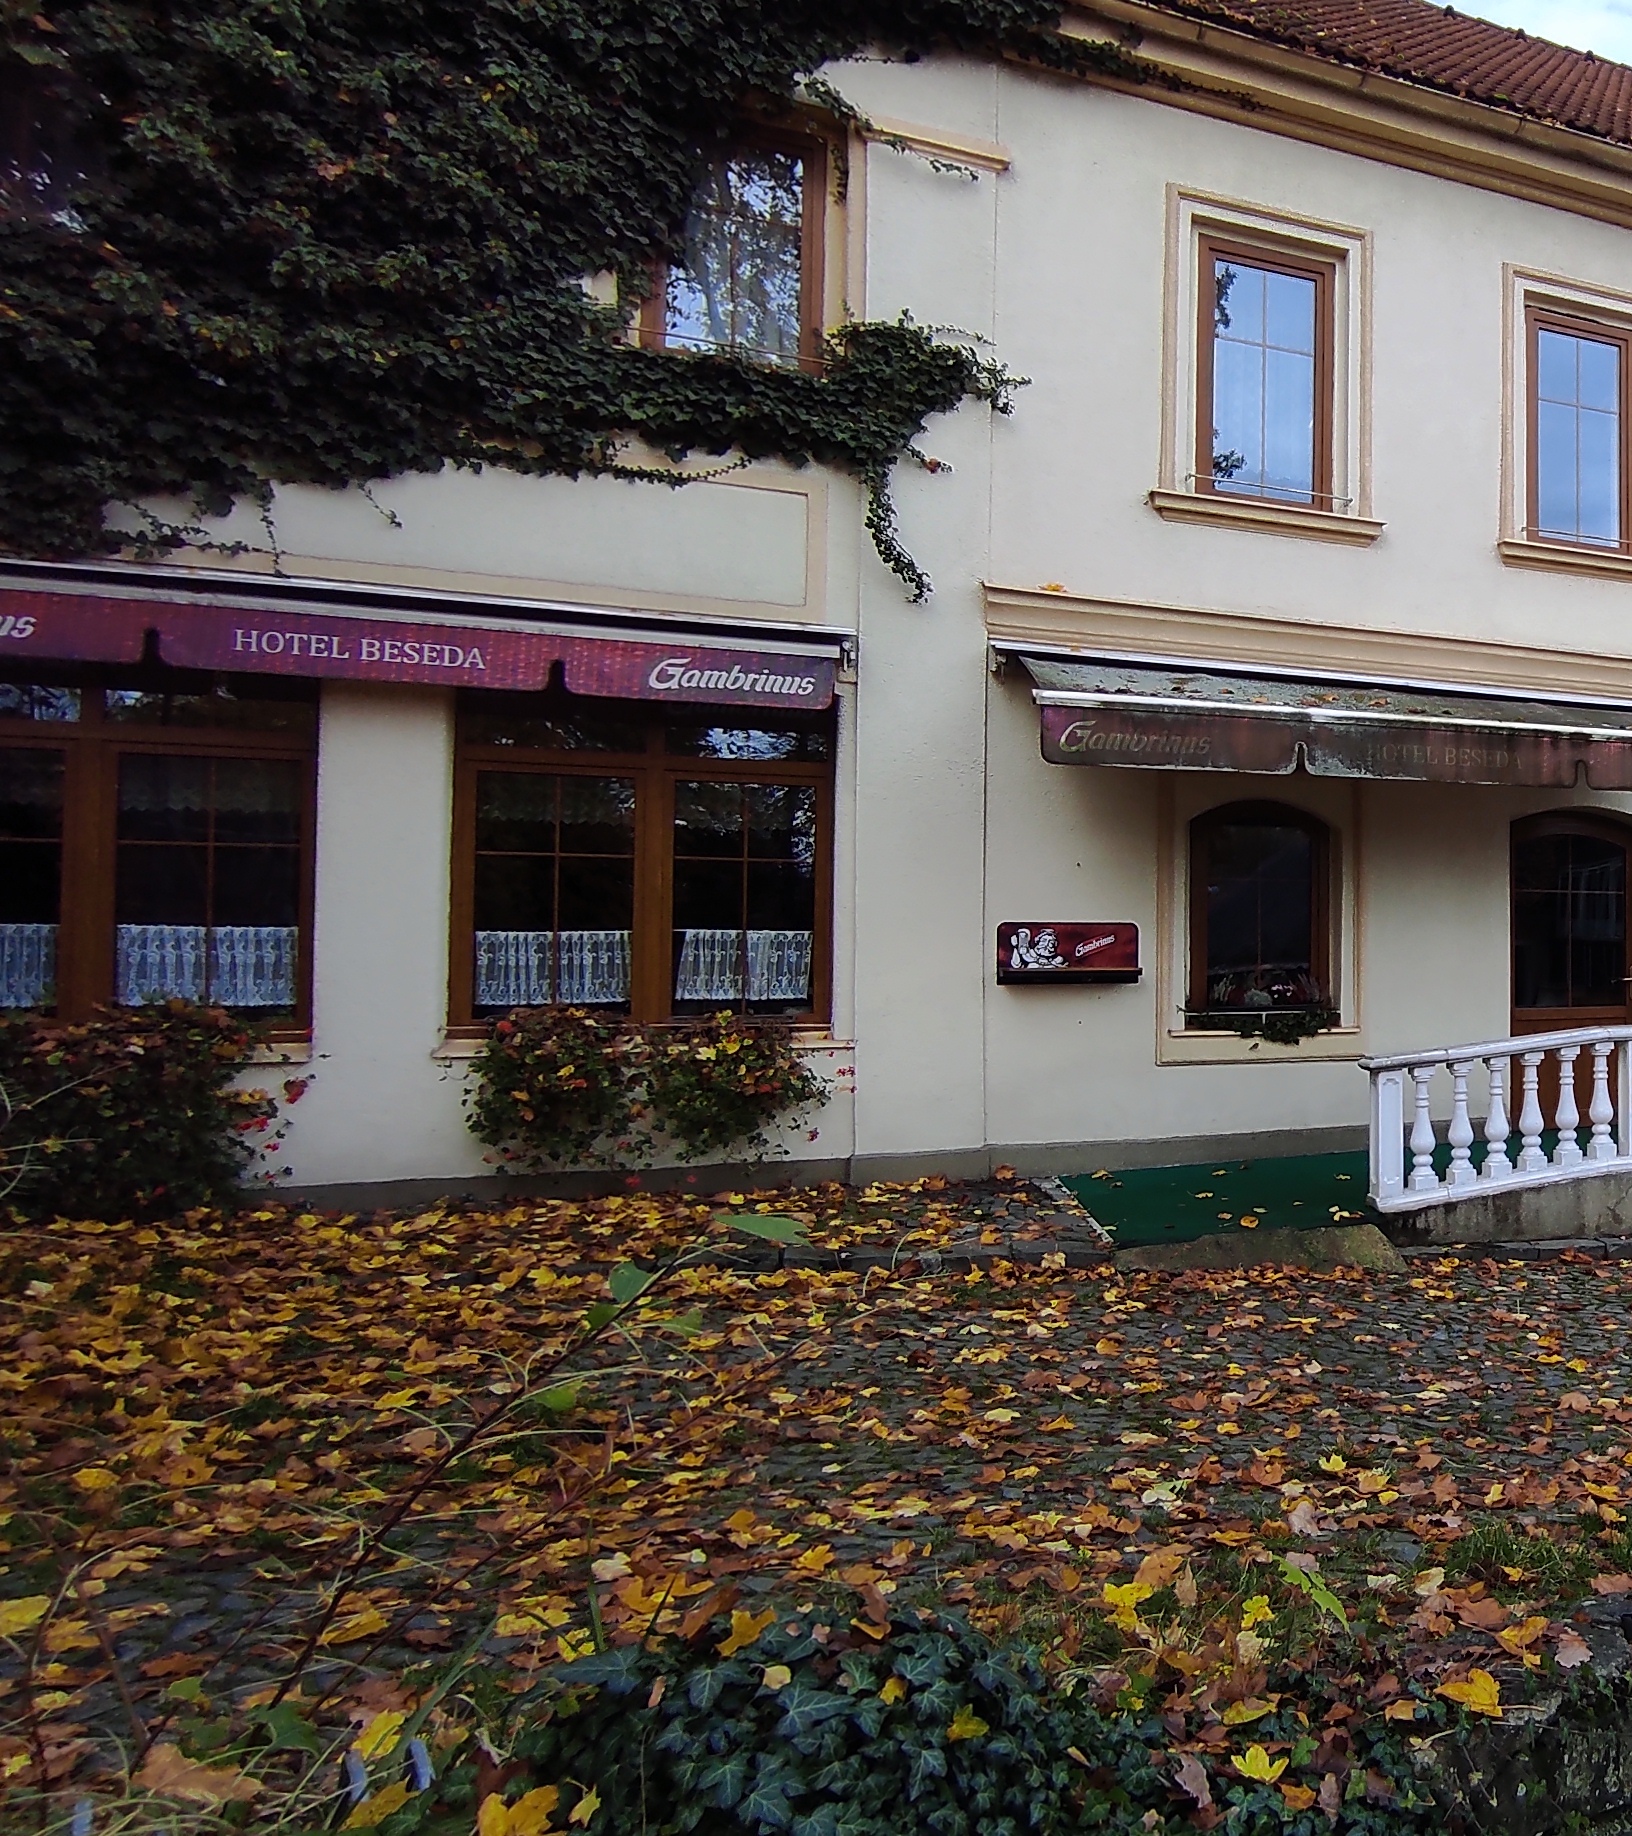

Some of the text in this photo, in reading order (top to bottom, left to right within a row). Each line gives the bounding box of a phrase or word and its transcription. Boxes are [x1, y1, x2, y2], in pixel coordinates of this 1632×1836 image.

[234, 629, 486, 670] HOTEL BESEDA
[650, 656, 816, 696] Gambrinus
[1059, 720, 1213, 754] Gambrinus
[1367, 743, 1523, 771] HOTEL BESEDA
[1075, 934, 1116, 957] Gambrinus
